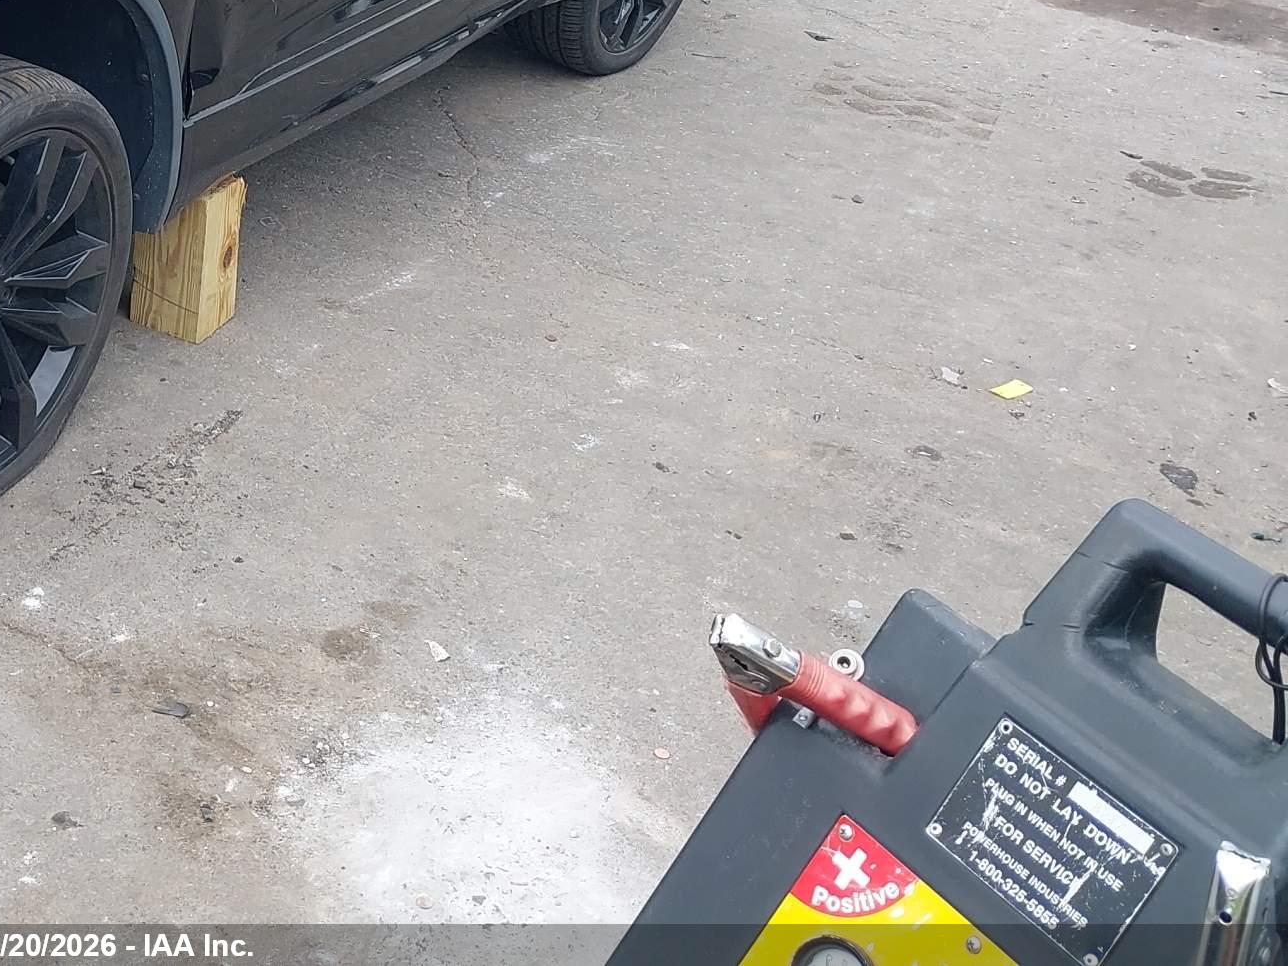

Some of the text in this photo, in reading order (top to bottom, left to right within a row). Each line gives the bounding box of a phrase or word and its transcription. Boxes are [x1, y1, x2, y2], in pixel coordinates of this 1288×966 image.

[1007, 738, 1067, 787] SERIAL #
[985, 778, 1124, 892] PLUG IN WHEN NOT IN USE
[994, 815, 1024, 845] FOR
[995, 754, 1132, 865] DO NOT LAY DOWN
[812, 881, 900, 914] Positive
[968, 850, 1060, 930] 1-800-325-5855
